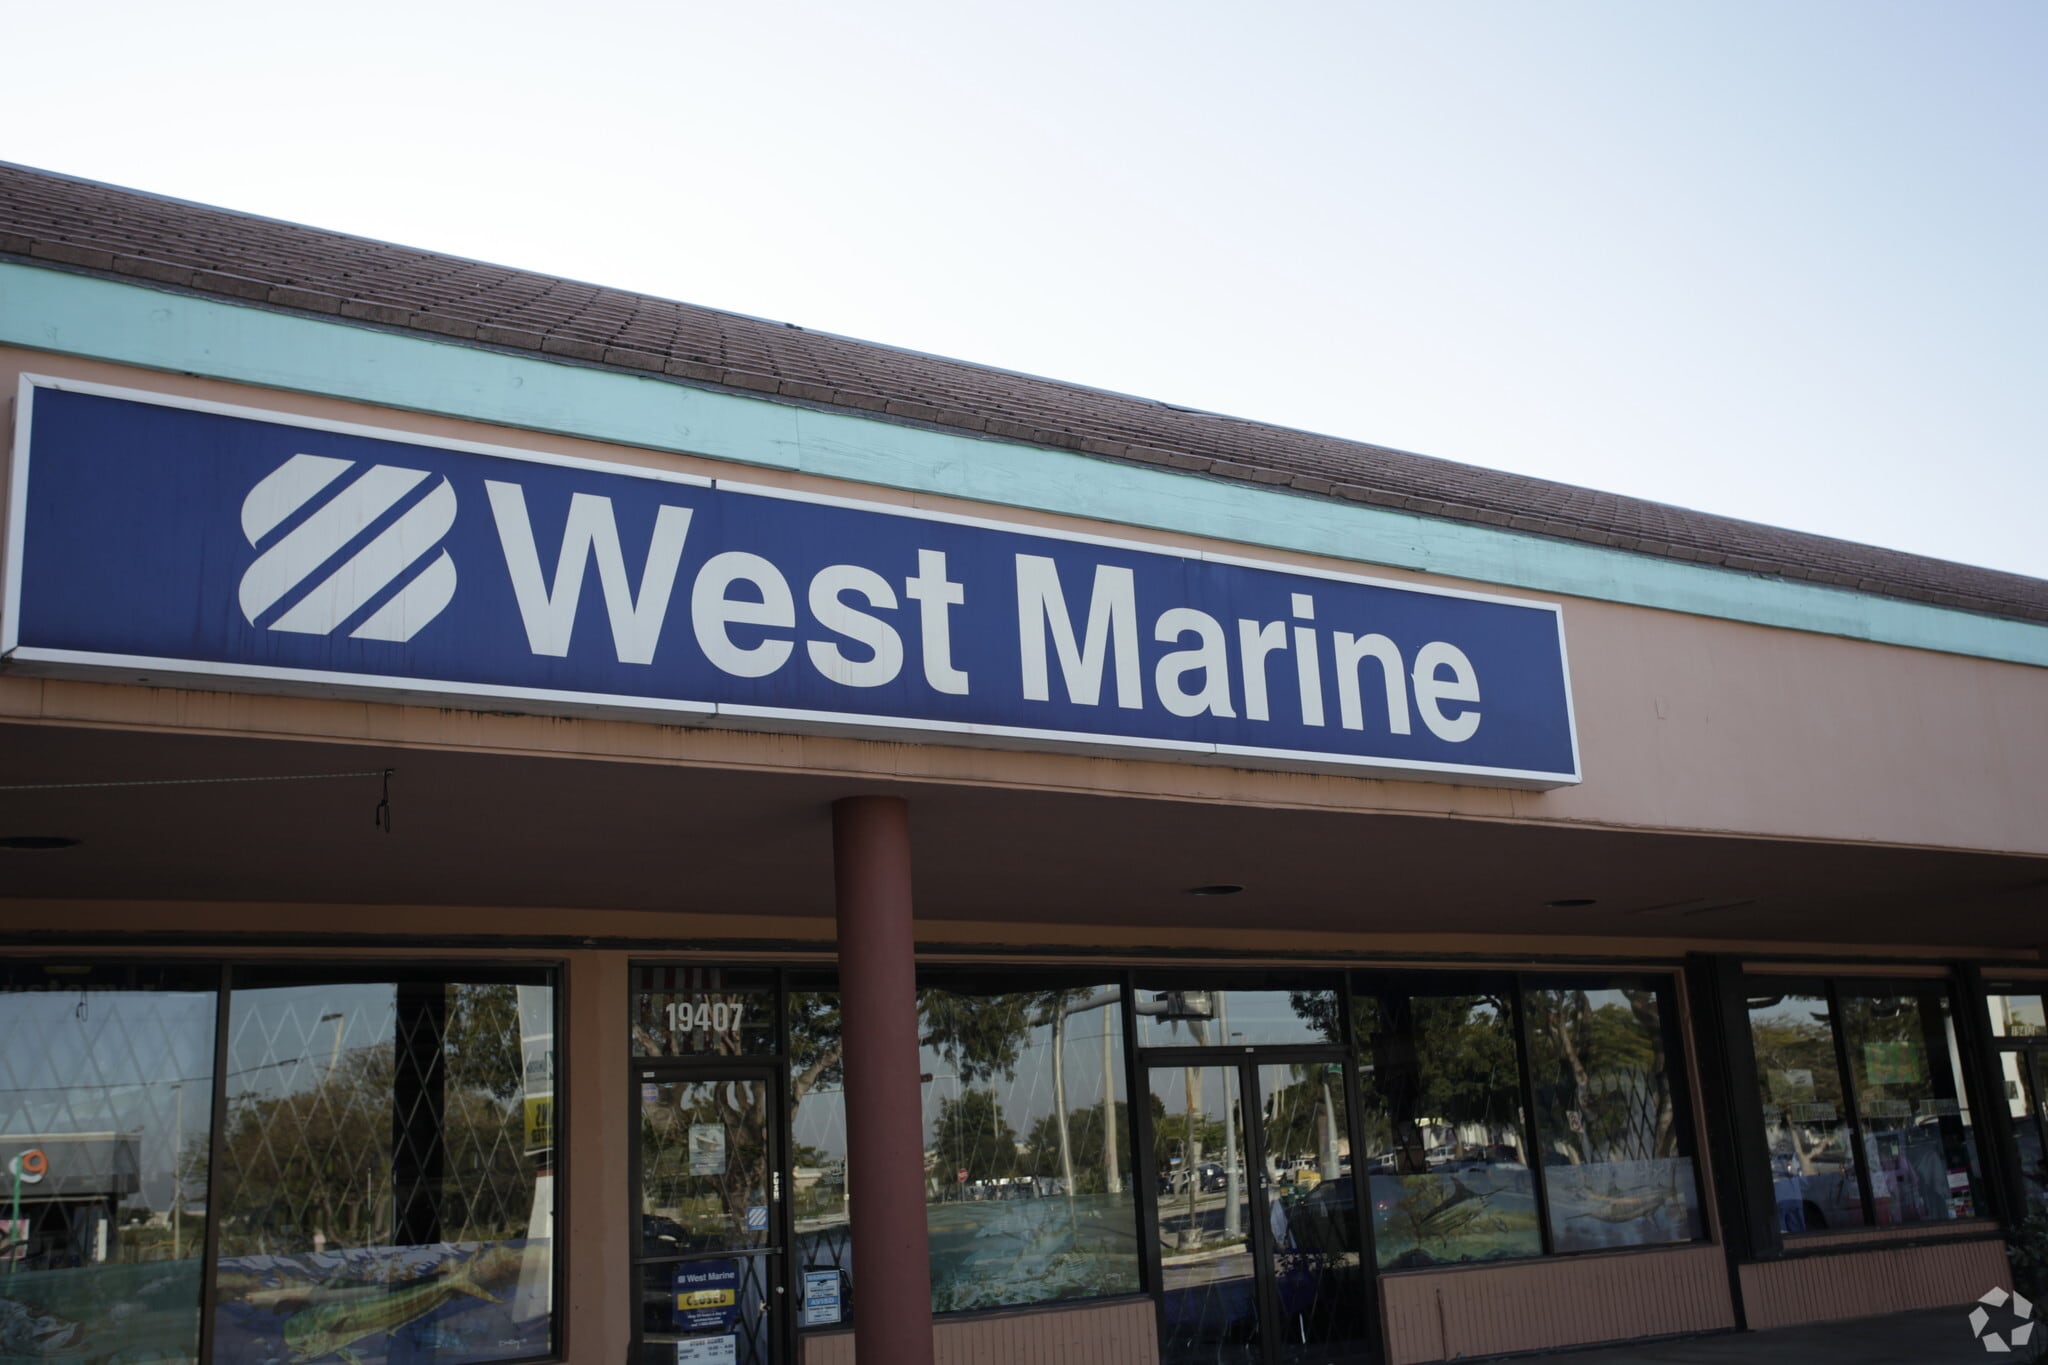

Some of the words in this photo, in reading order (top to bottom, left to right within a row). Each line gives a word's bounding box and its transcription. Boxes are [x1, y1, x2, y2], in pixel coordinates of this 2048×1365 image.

[484, 479, 969, 696] West
[1015, 553, 1482, 743] Marine
[665, 1002, 743, 1032] 19407
[687, 1273, 707, 1283] West
[708, 1271, 735, 1281] Marine
